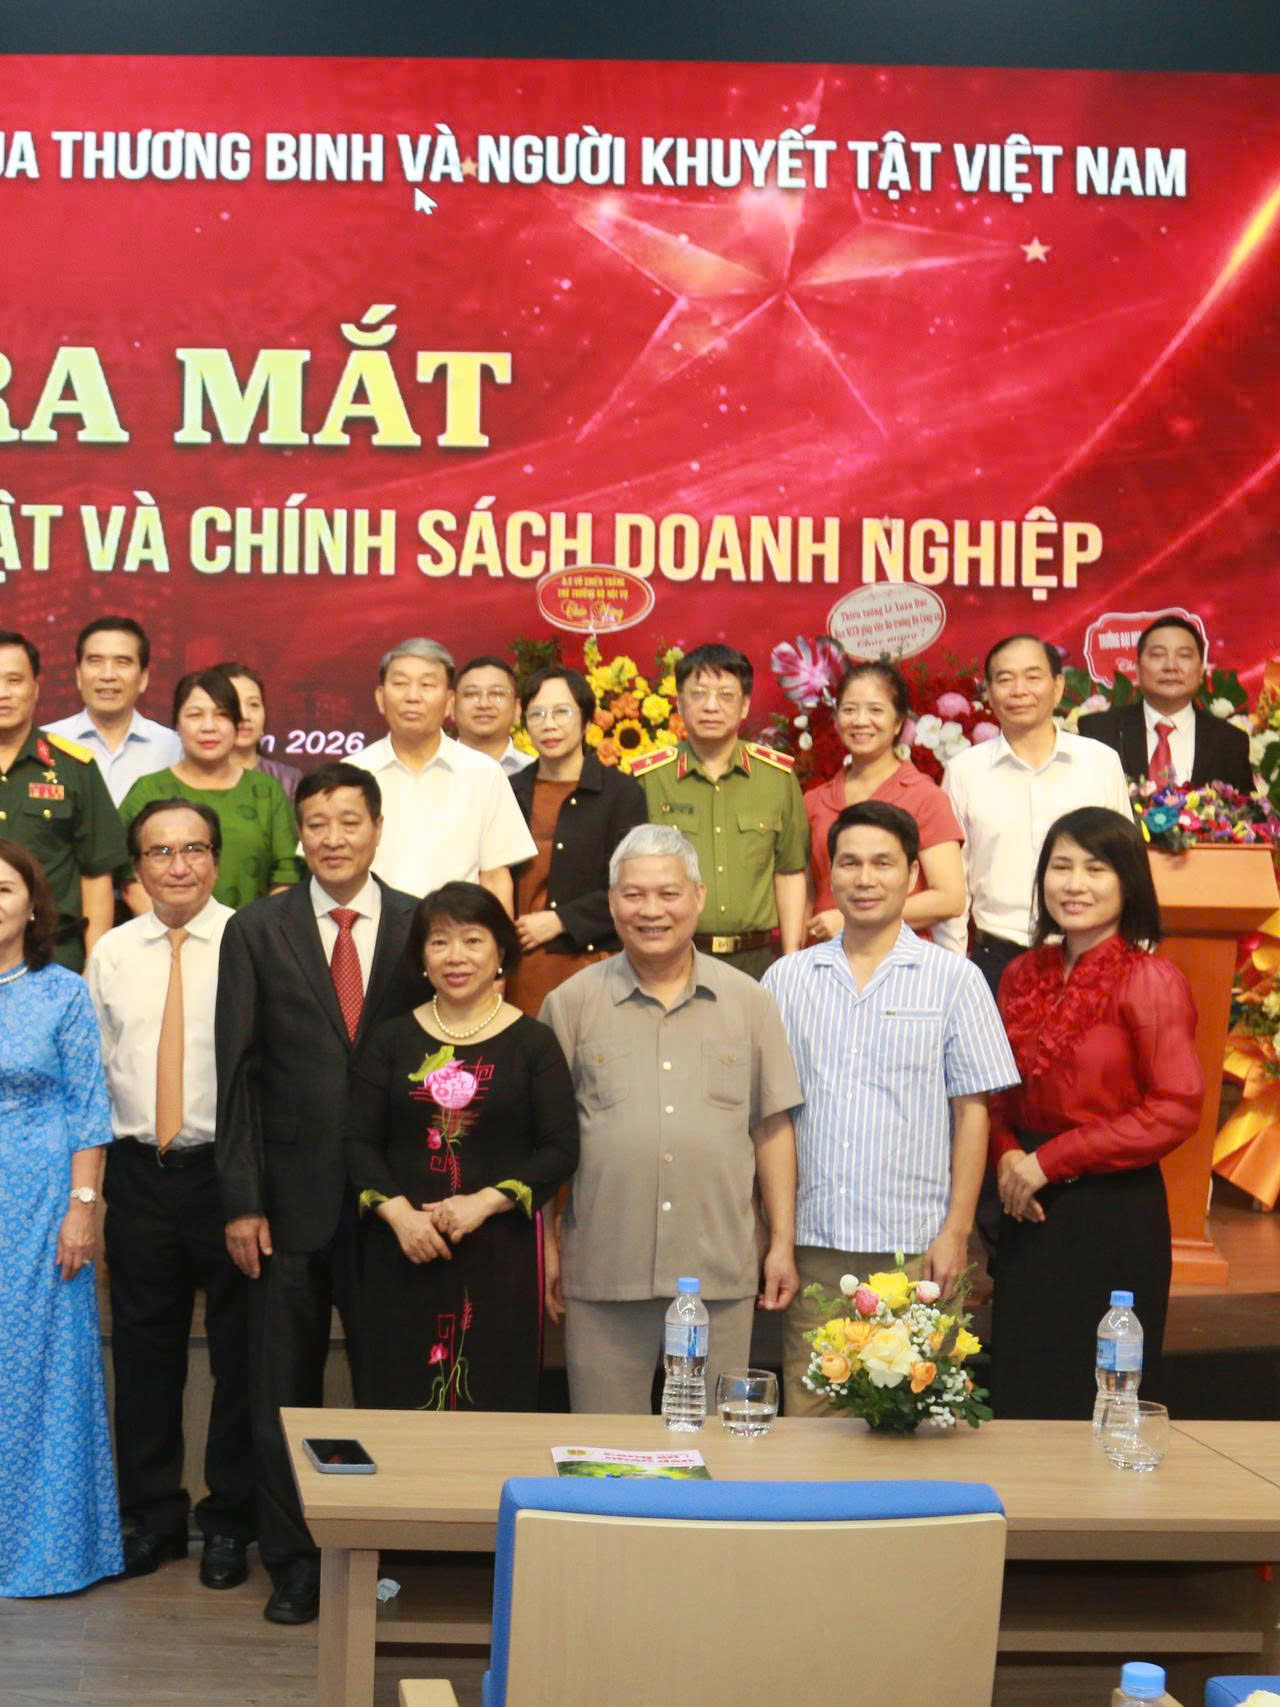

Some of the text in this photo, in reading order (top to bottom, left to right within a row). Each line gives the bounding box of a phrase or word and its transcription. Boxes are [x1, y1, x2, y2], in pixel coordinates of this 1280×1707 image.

[51, 128, 251, 181] THƯƠNG
[265, 132, 384, 182] BINH
[403, 123, 464, 182] VÀ
[477, 125, 626, 185] NGƯỜI
[641, 124, 837, 188] KHUYẾT
[847, 130, 942, 200] TẬT
[953, 133, 1063, 203] VIỆT
[1076, 146, 1186, 197] NAM
[173, 304, 512, 448] MẮT
[80, 490, 170, 573] VÀ
[190, 492, 397, 576] CHÍNH
[417, 495, 593, 578] SÁCH
[613, 513, 840, 584] DOANH
[861, 506, 1103, 601] NGHIỆP
[285, 729, 366, 755] 2026
